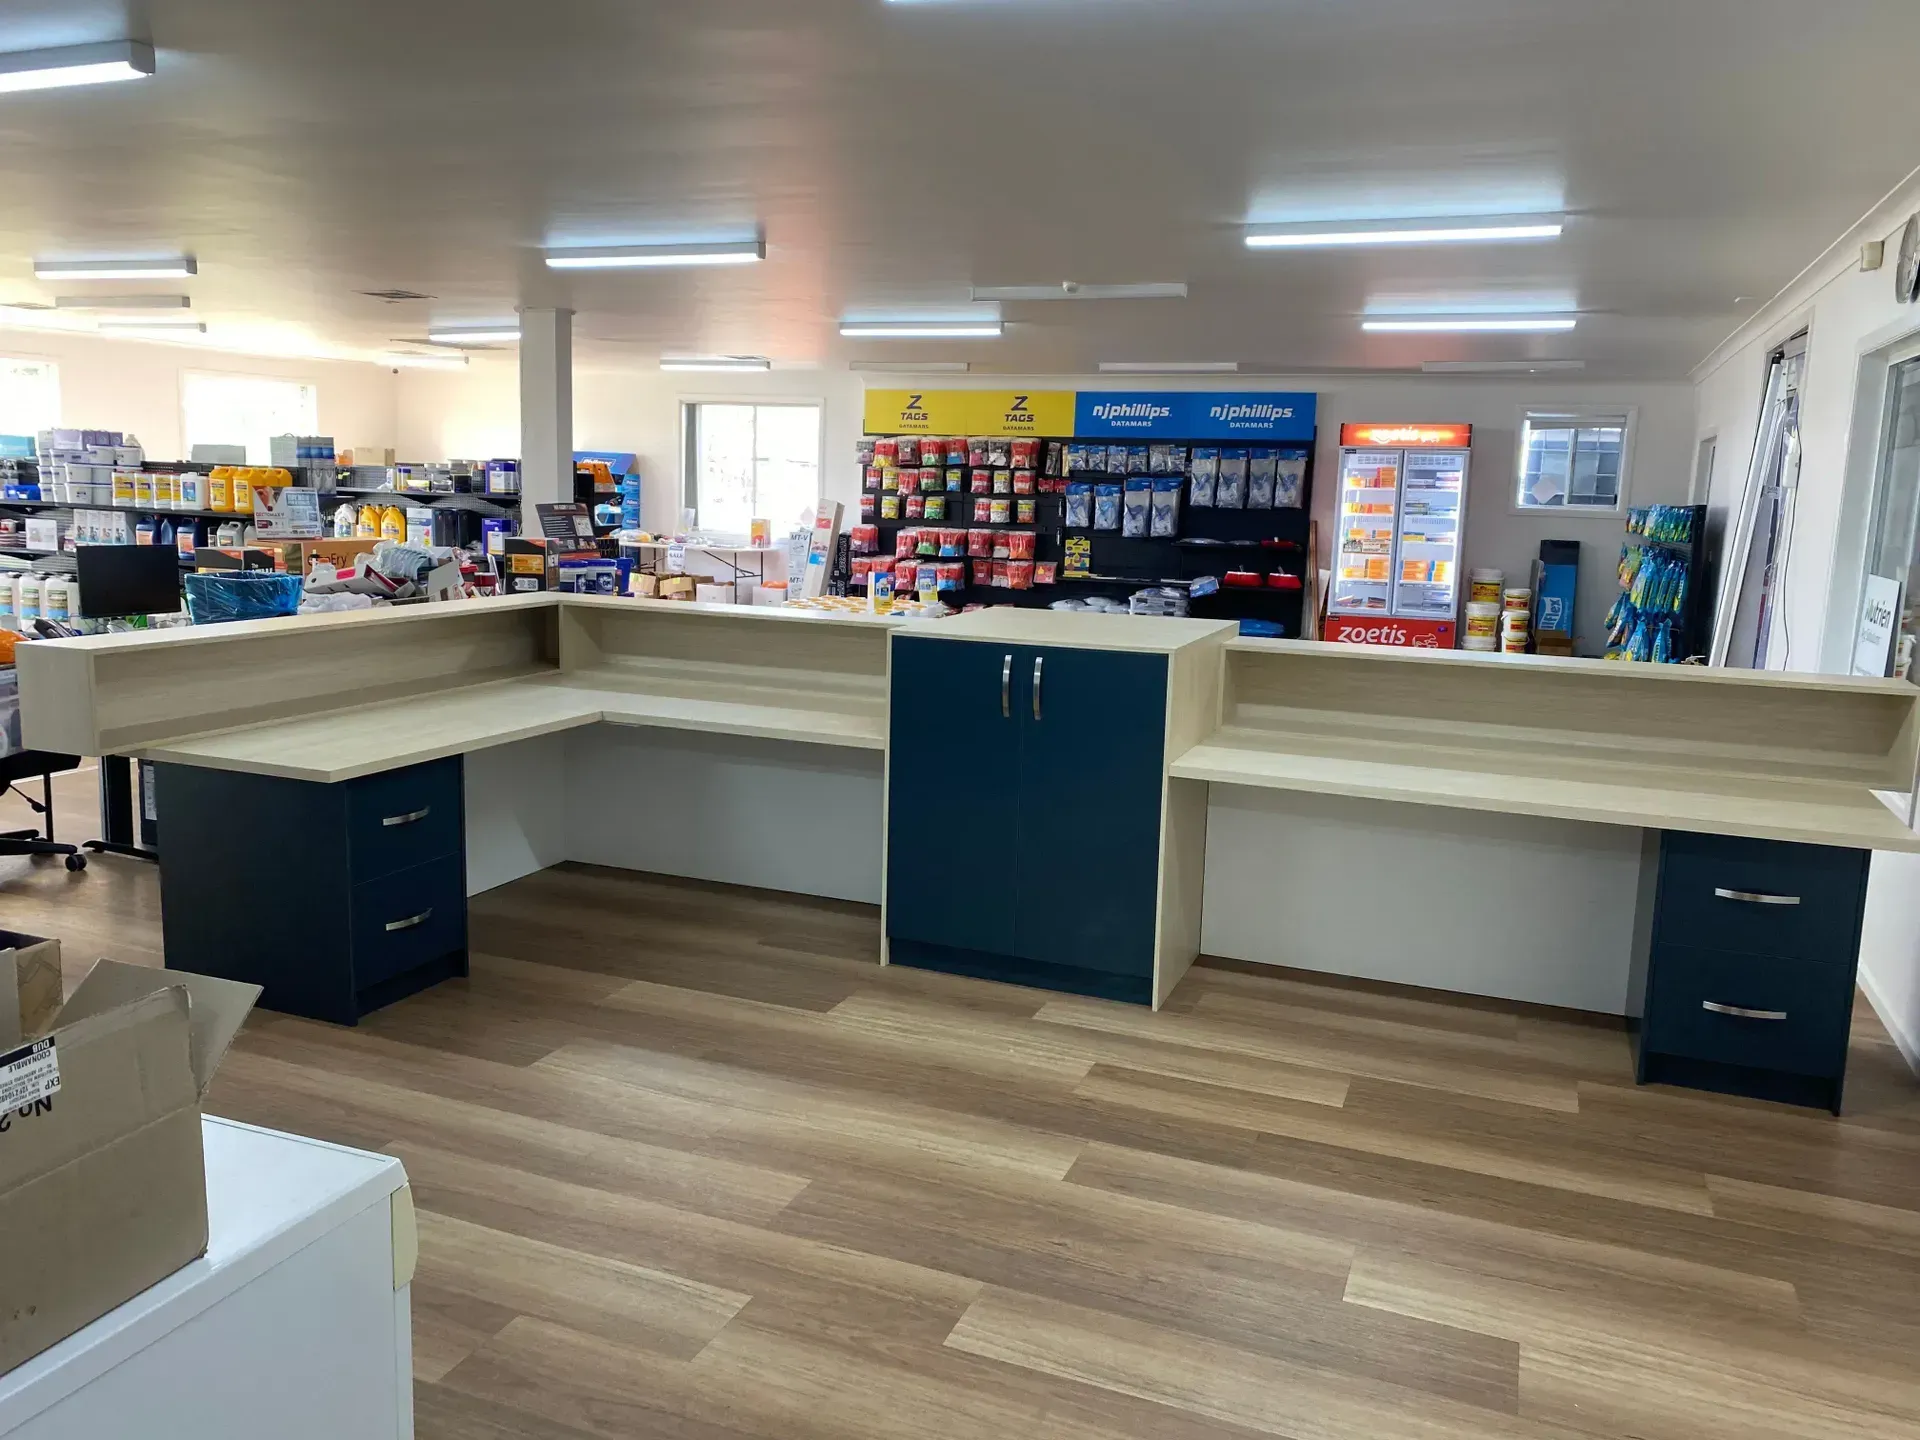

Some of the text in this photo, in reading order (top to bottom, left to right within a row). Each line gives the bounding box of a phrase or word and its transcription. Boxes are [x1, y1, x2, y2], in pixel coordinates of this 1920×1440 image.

[906, 395, 922, 410] Z
[1011, 396, 1028, 411] Z
[900, 412, 928, 421] TAGS
[1004, 414, 1034, 422] TAGS
[1092, 403, 1170, 419] njphillips
[1210, 404, 1292, 421] njphillips
[1337, 624, 1407, 645] zoetis
[32, 1039, 50, 1053] DUB
[8, 1049, 51, 1074] COONAMBLE
[44, 1075, 61, 1091] EXP
